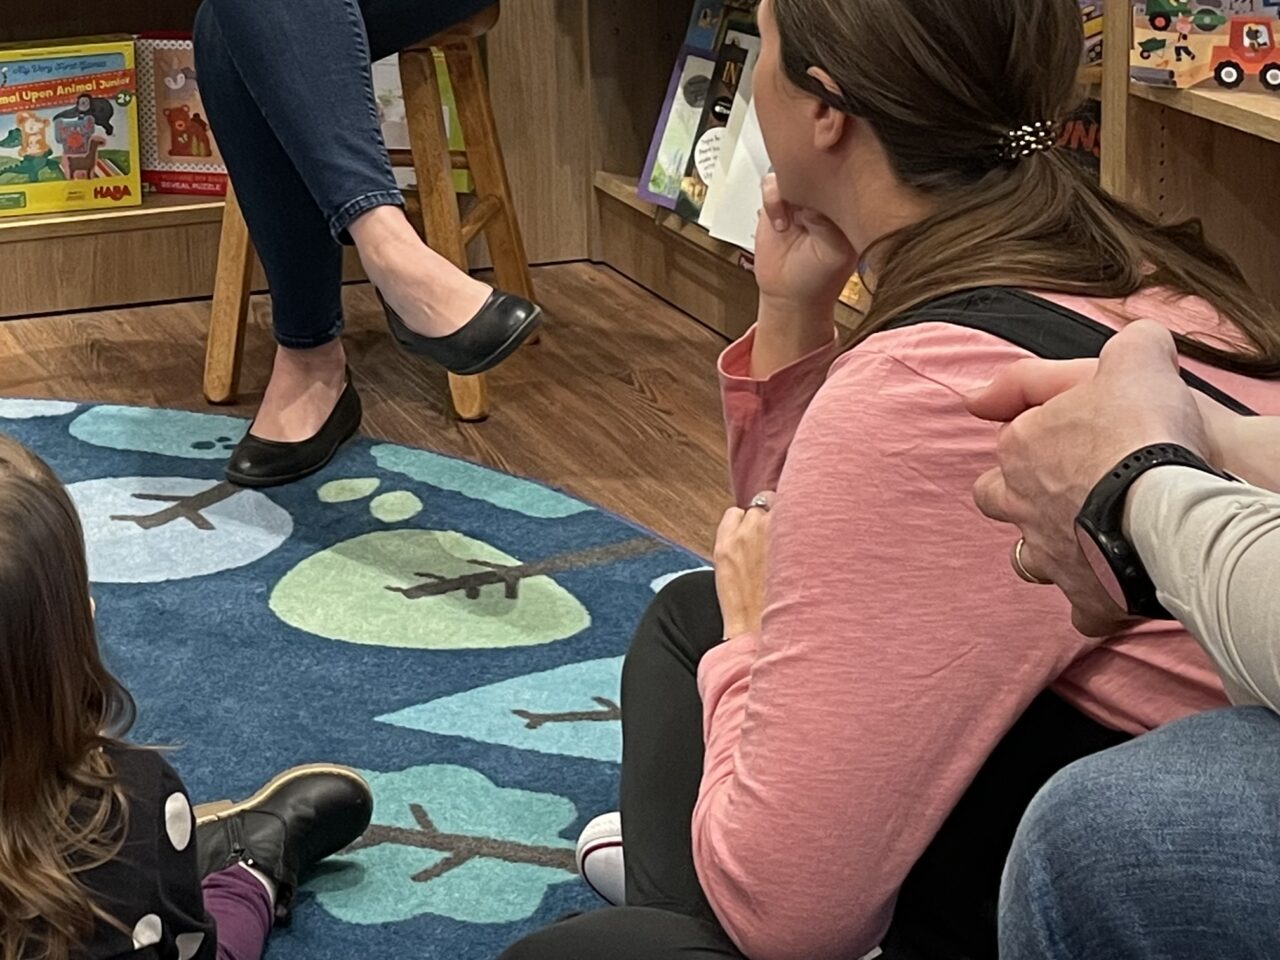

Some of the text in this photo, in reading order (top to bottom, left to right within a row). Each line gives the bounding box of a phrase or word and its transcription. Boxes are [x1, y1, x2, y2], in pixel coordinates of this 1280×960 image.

[22, 88, 54, 103] Upon
[56, 79, 97, 96] Animal
[99, 76, 131, 89] Junior
[117, 93, 131, 104] 2+
[93, 184, 132, 202] HABA
